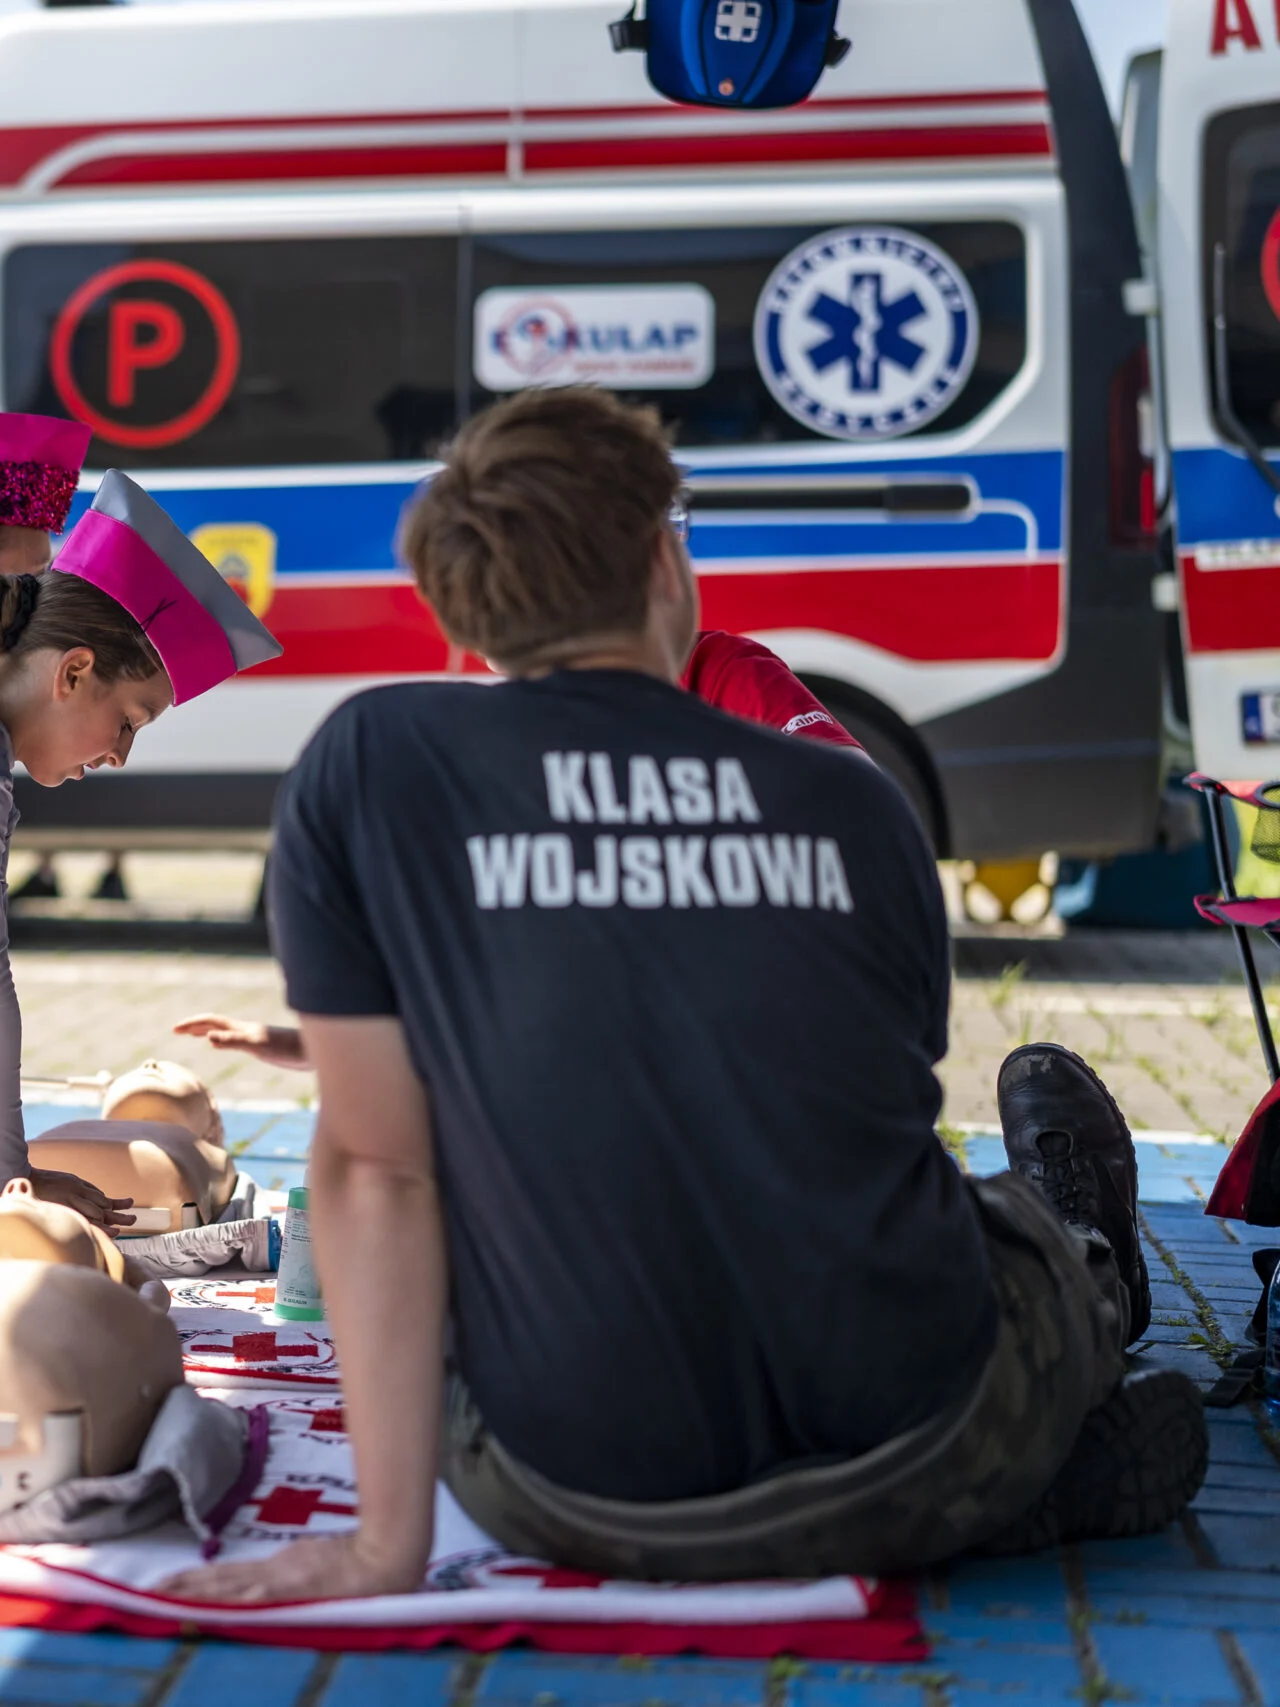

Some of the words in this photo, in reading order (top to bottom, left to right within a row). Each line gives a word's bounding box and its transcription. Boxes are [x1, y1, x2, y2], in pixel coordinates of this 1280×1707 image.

[108, 300, 183, 406] P
[543, 751, 762, 825] KLASA
[467, 833, 854, 914] WOJSKOWA
